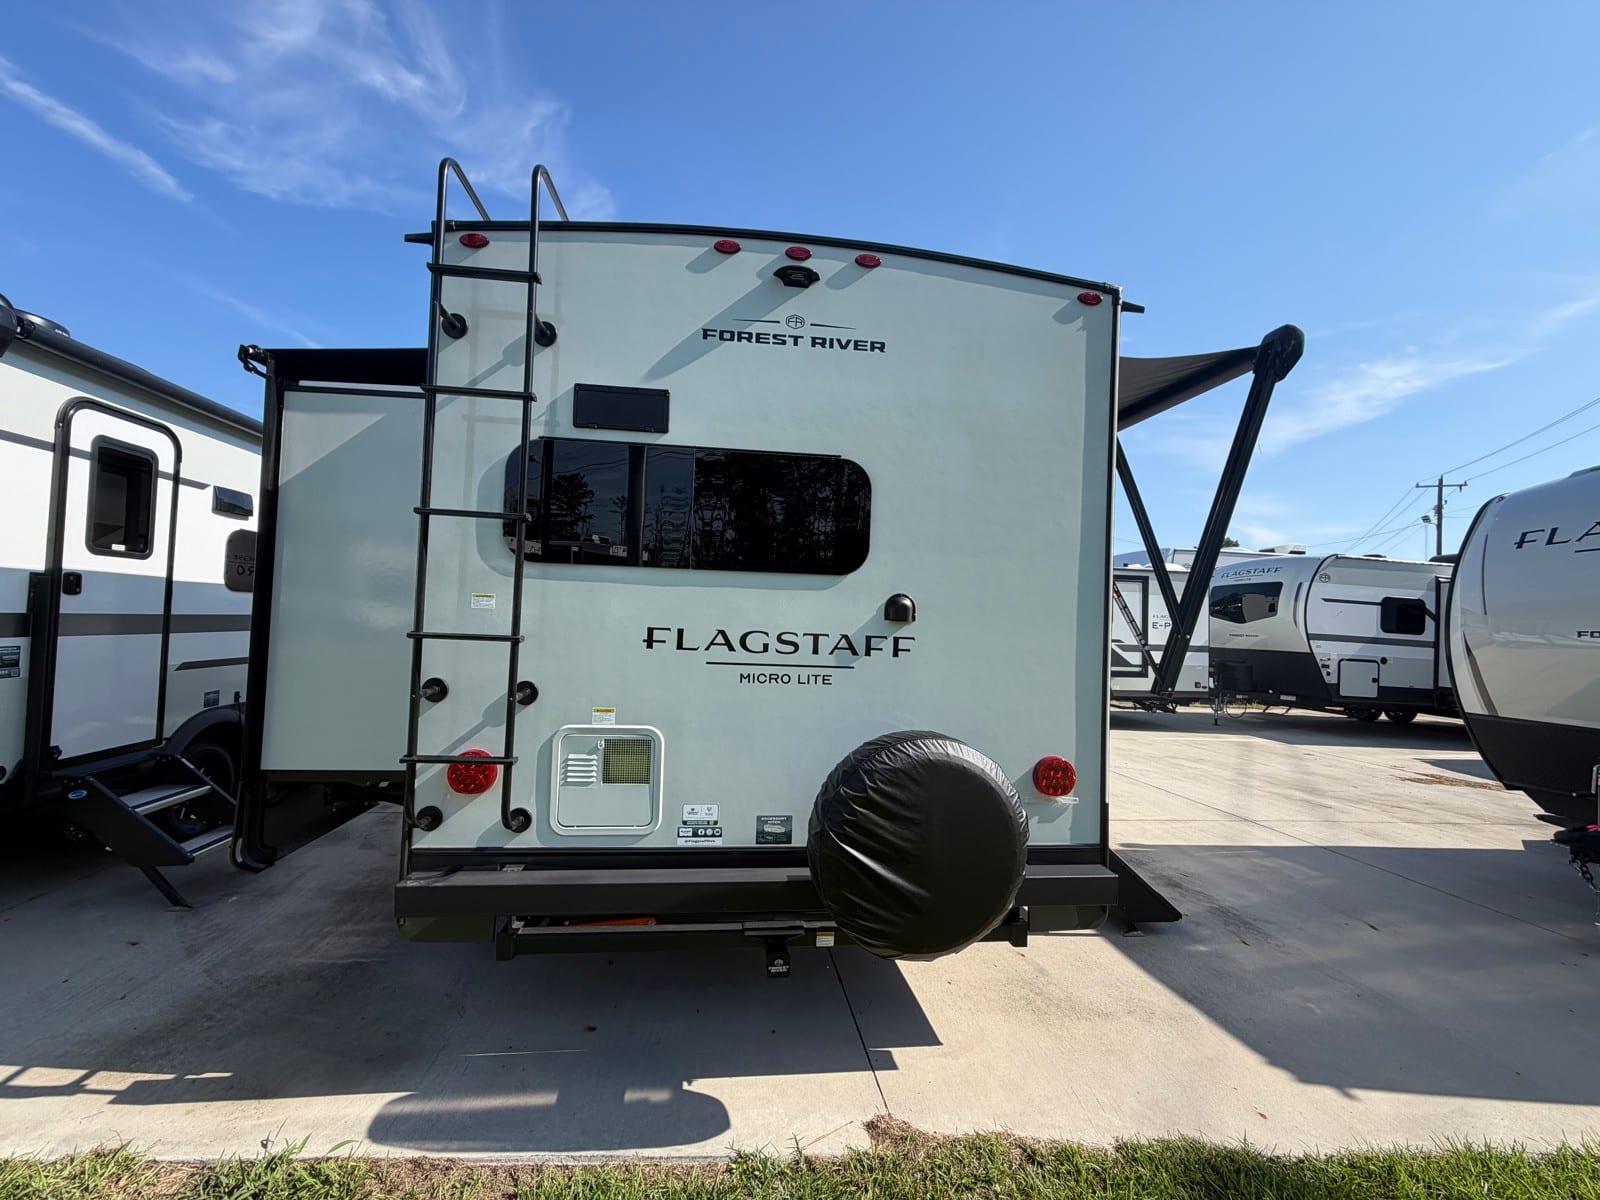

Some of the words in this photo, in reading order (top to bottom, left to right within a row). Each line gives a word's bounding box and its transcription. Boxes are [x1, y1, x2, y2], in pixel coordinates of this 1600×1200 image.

[702, 328, 804, 347] FOREST
[810, 336, 886, 353] RIVER
[1221, 566, 1284, 579] FLAGSTAFF
[643, 627, 916, 658] FLAGSTAFF
[740, 673, 791, 685] MICRO
[797, 674, 833, 686] LITE
